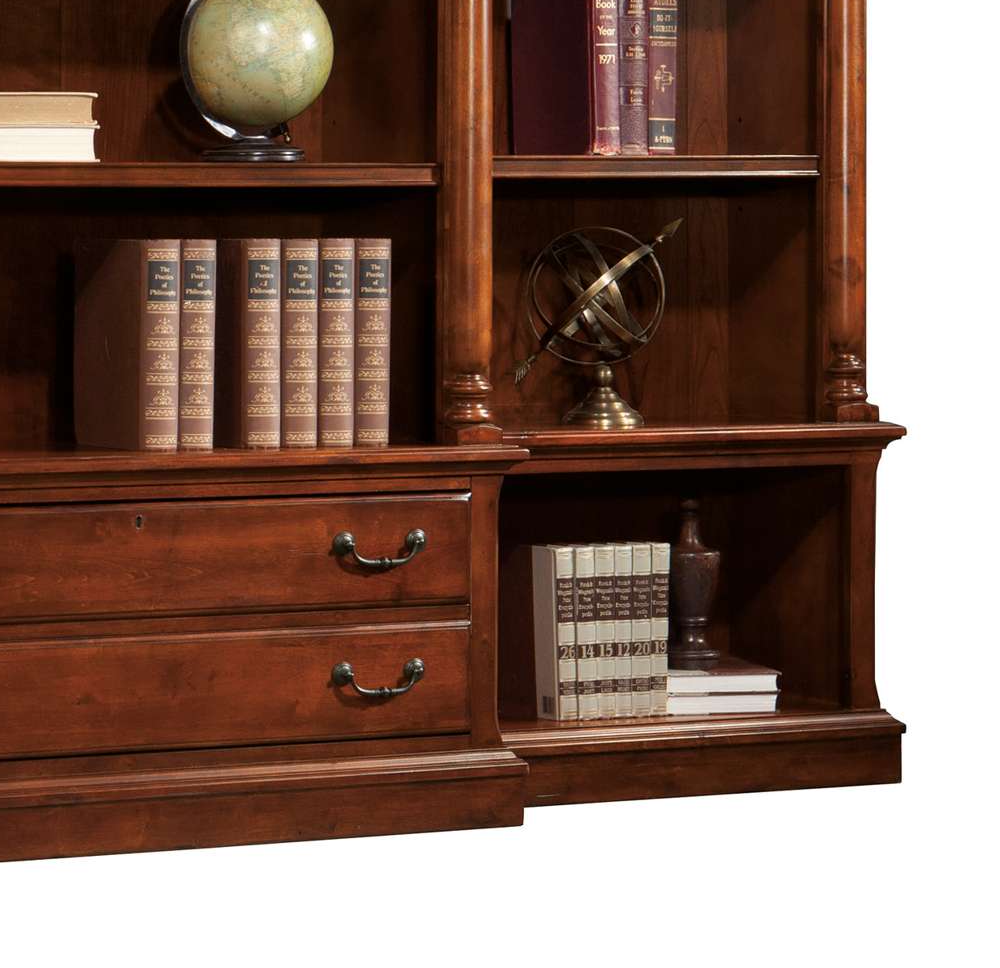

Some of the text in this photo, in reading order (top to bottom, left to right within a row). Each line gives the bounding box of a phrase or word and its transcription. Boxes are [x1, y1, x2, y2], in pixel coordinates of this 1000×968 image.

[597, 25, 616, 36] Year
[598, 54, 616, 64] 1971
[561, 646, 576, 658] 26
[582, 645, 594, 658] 14
[600, 644, 613, 657] 15
[617, 643, 630, 656] 12
[634, 642, 650, 656] 20
[655, 641, 667, 654] 19
